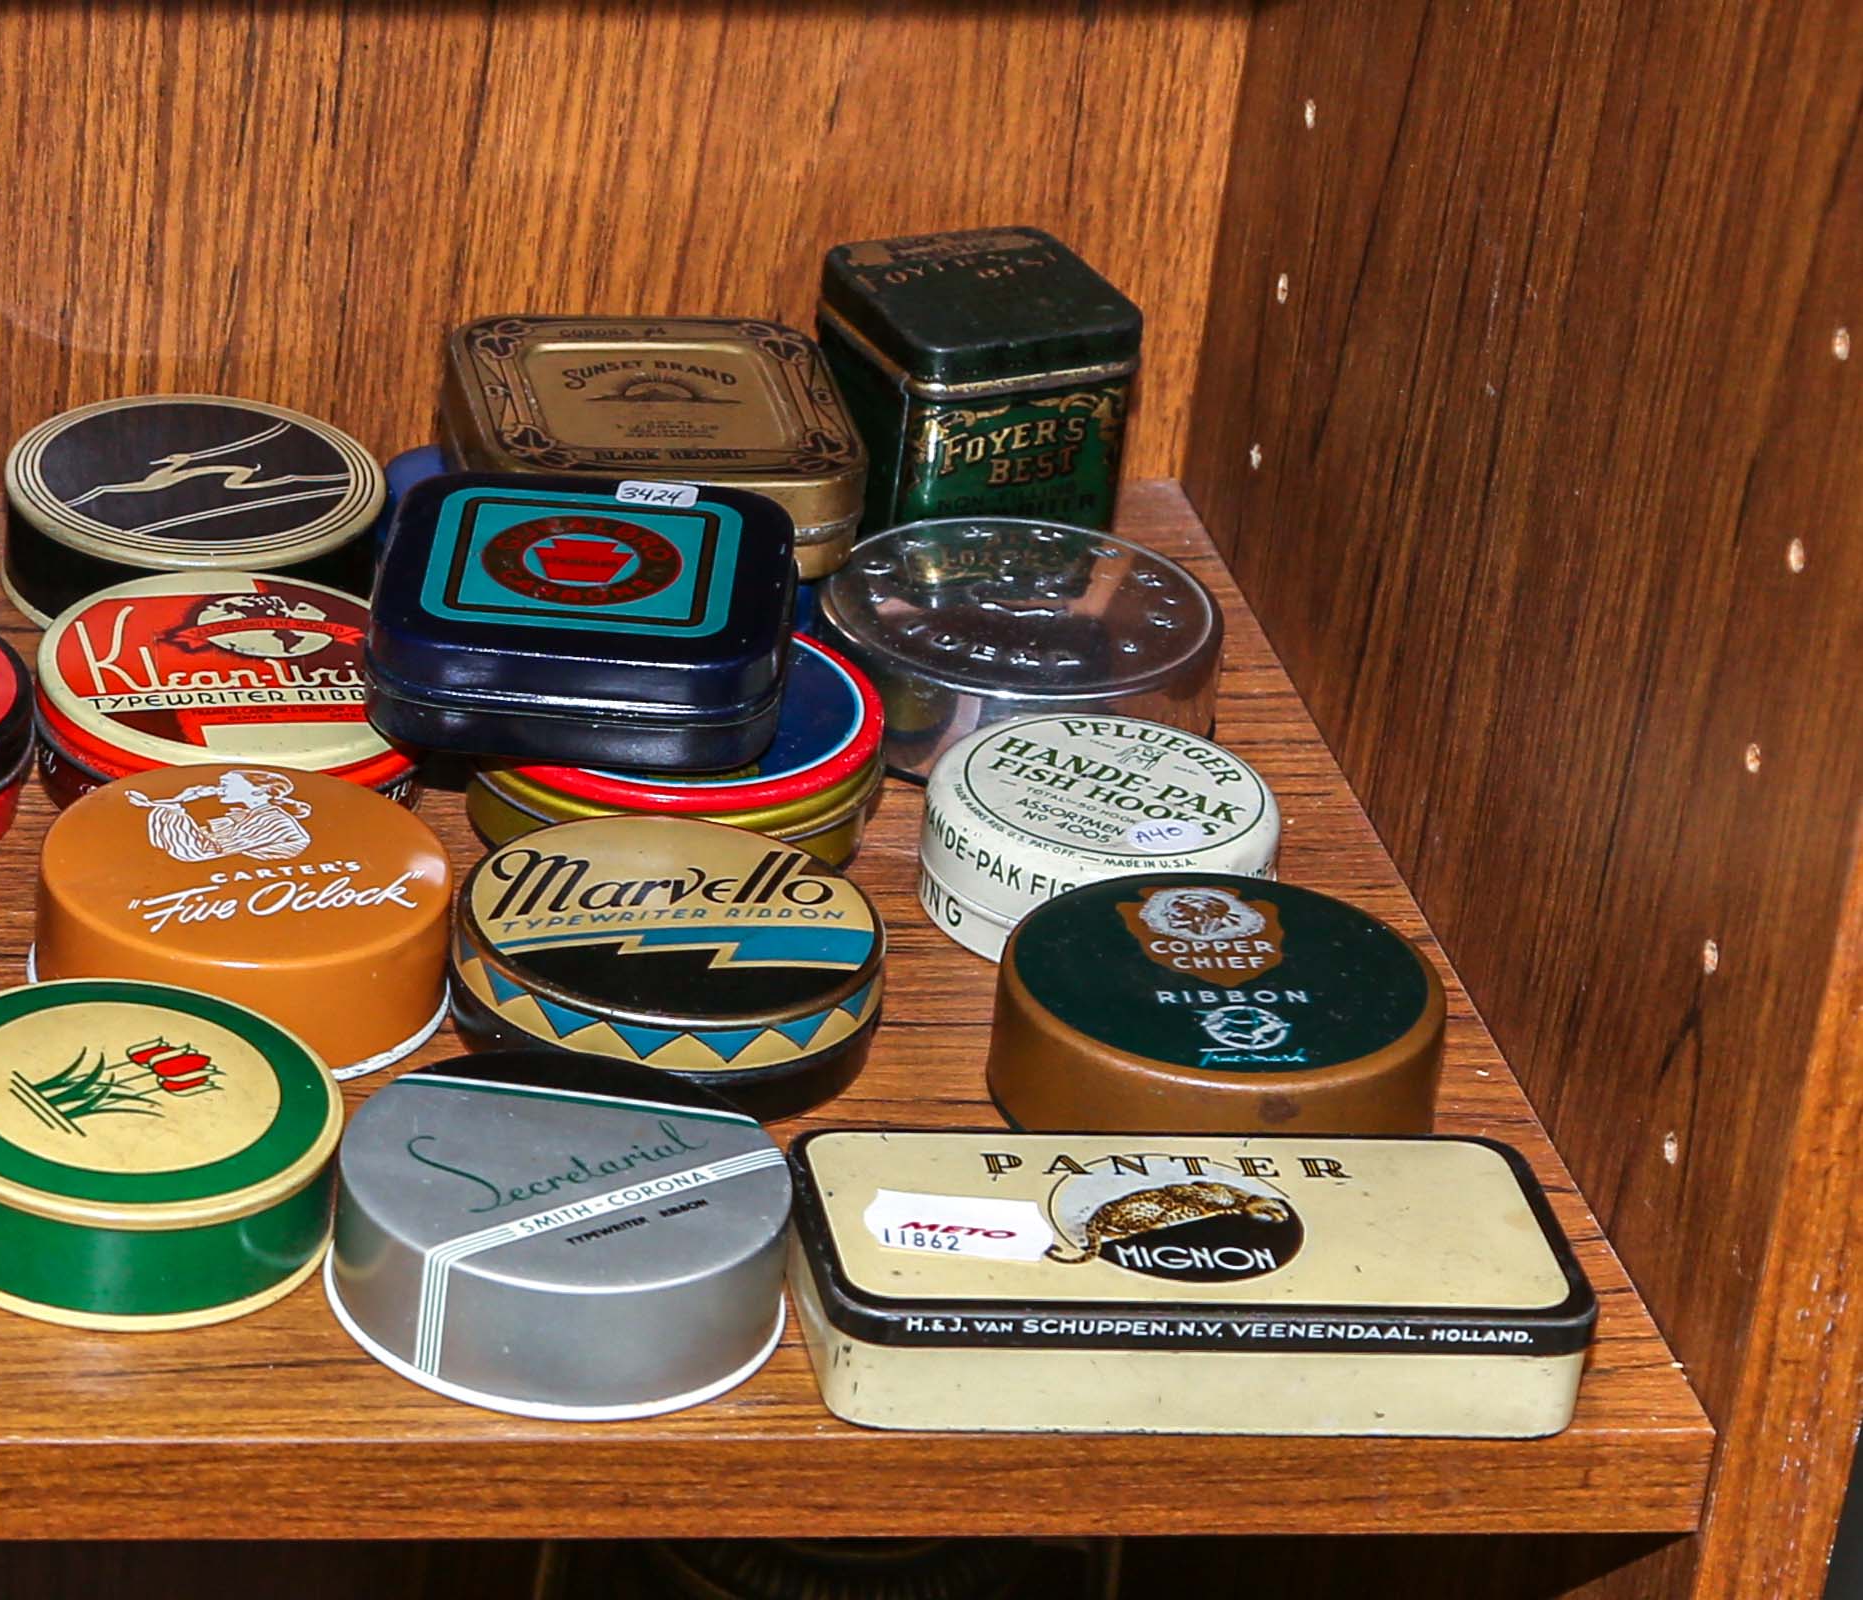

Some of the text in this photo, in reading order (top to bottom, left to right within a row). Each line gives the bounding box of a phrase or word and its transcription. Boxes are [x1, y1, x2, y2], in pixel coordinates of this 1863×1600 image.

[562, 360, 736, 390] SUNSET BRAND
[939, 417, 1086, 474] FOYER'S
[988, 449, 1078, 485] BEST
[620, 486, 684, 505] 3424
[89, 689, 285, 710] TYPEWRITER
[1059, 719, 1244, 787] PFLUEGER
[995, 736, 1247, 826] HANDE-PAK
[988, 758, 1223, 837] FISH HOOKS
[1055, 819, 1112, 844] 4005
[1134, 827, 1183, 844] A40
[210, 861, 362, 883] CARTER'S
[1103, 857, 1141, 868] MADE
[488, 848, 834, 921] Marvello
[501, 908, 846, 933] TYPEWRITER RIBBON
[1149, 940, 1276, 954] COPPER
[1173, 956, 1266, 970] CHIEF
[1155, 989, 1309, 1004] RIBBON
[407, 1120, 710, 1213] Secretarial
[978, 1151, 1355, 1181] PANTER
[566, 1198, 710, 1246] TYPEWRITER RIBBON
[898, 1220, 1019, 1241] METO
[881, 1228, 962, 1253] 11862
[1116, 1243, 1278, 1271] MIGNON
